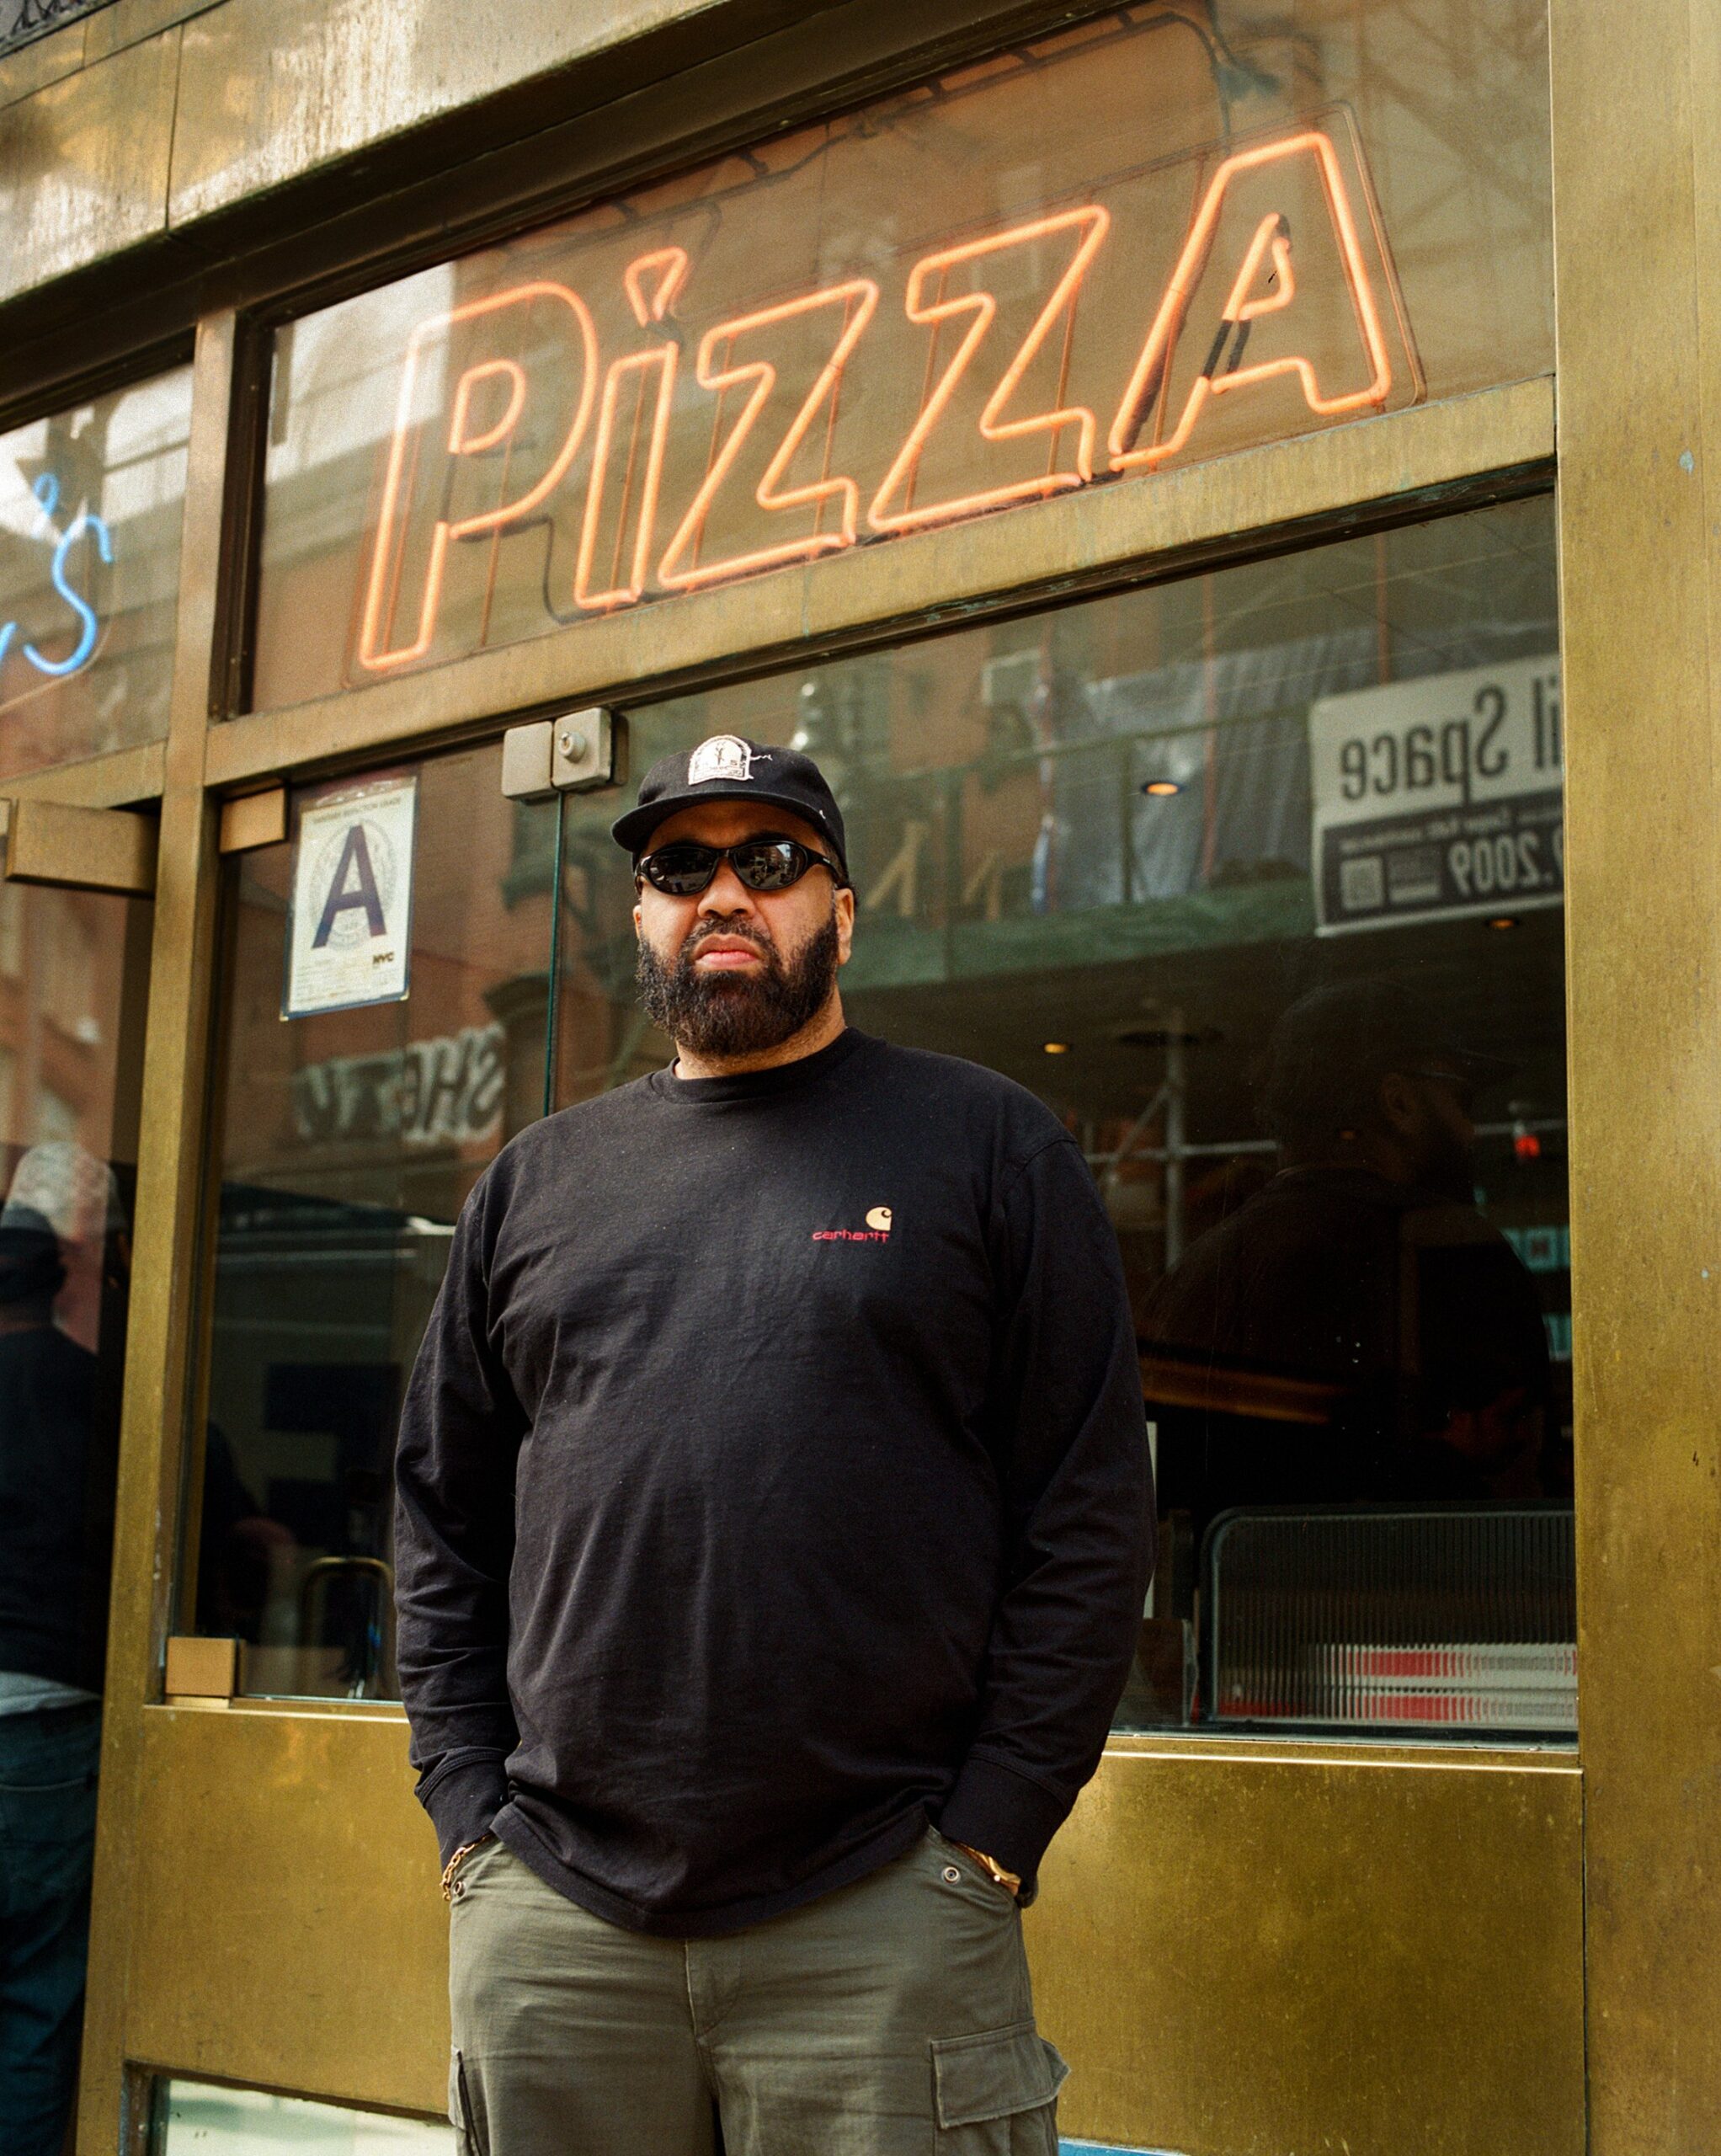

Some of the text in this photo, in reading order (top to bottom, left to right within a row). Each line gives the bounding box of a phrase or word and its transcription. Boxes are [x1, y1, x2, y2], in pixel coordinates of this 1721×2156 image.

[312, 824, 386, 950] A
[372, 952, 395, 965] NYC
[812, 1229, 889, 1243] carhartt
